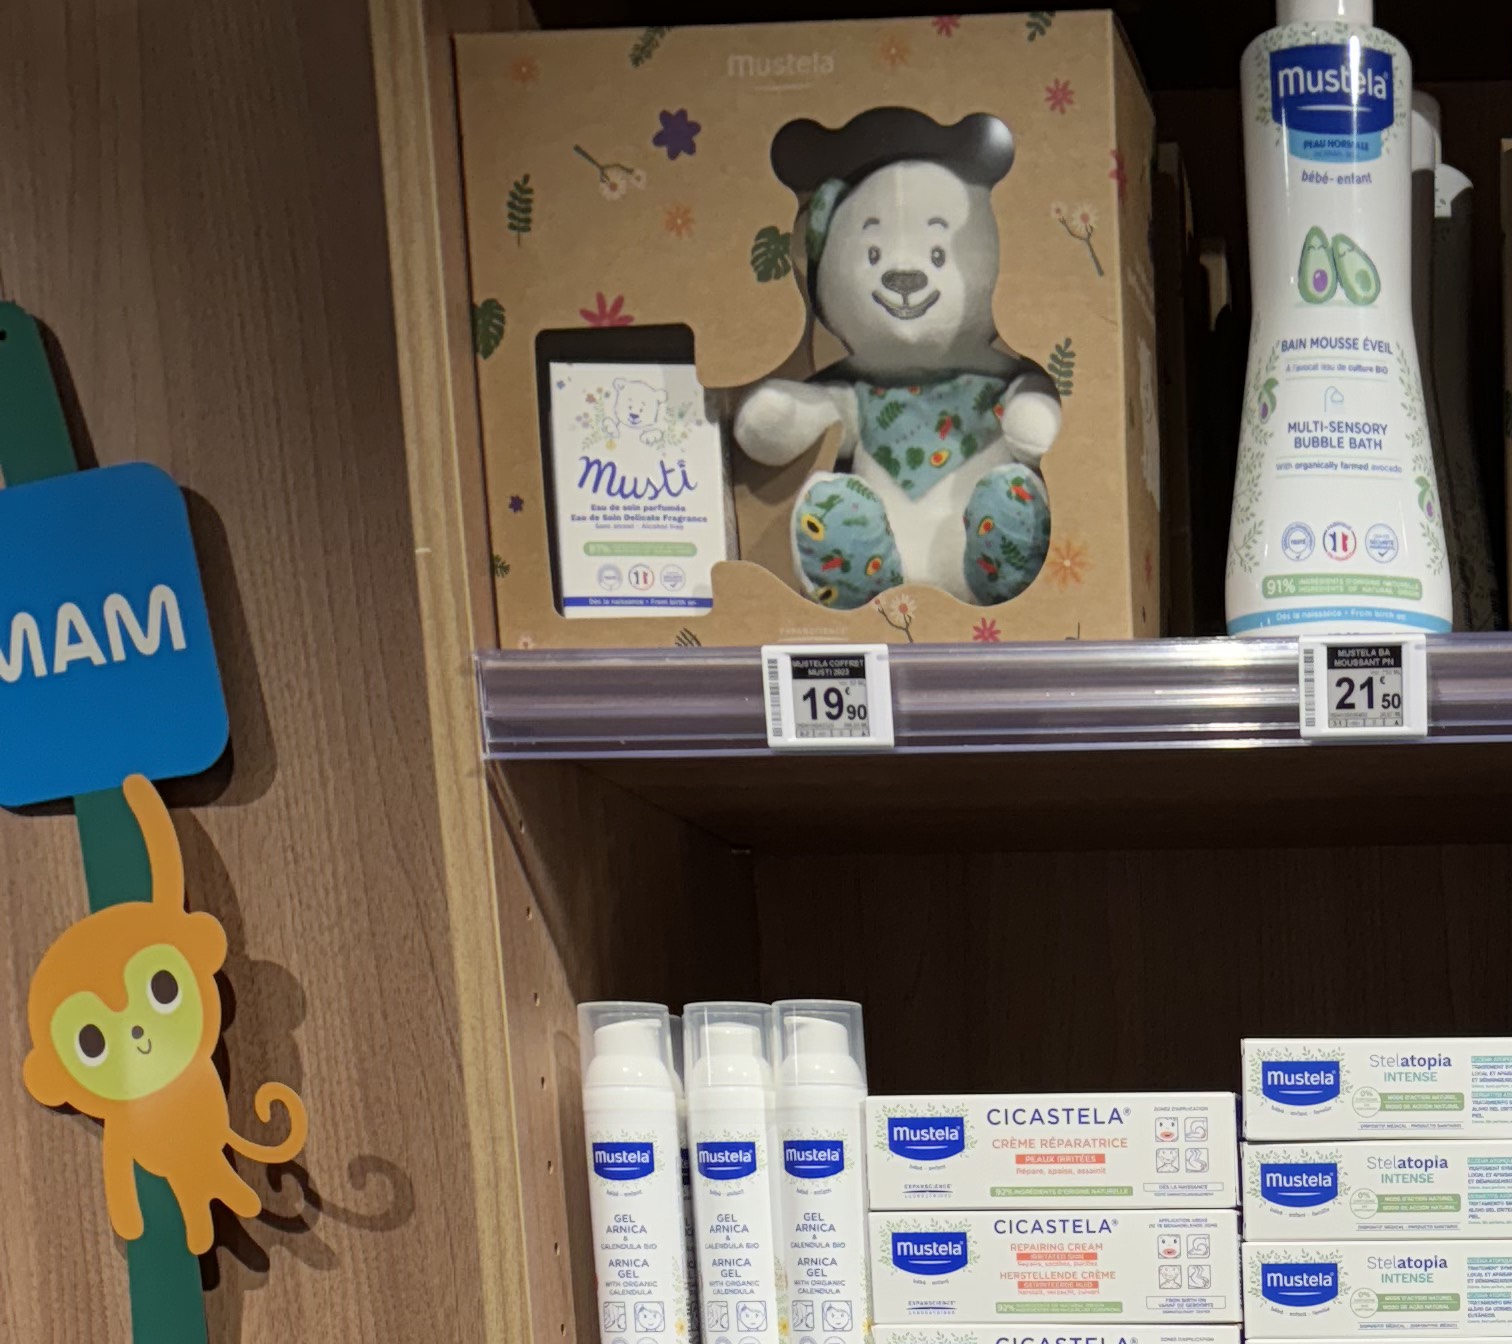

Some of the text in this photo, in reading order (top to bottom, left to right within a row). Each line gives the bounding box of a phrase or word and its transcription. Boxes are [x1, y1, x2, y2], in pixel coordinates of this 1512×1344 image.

[1281, 338, 1306, 352] BAIN
[1310, 336, 1359, 350] MOUSSE
[1288, 421, 1388, 435] MULTI-SENSORY
[1294, 437, 1382, 450] BUBBLE BATH
[578, 456, 698, 500] Musti
[1370, 1053, 1453, 1070] Stelatopia
[1267, 1069, 1334, 1086] Mustela
[1384, 1072, 1438, 1082] INTENSE
[987, 1107, 1123, 1126] CICASTELA
[893, 1124, 959, 1144] Mustela
[992, 1134, 1128, 1150] CRÈME RÉPARATRICE
[1367, 1157, 1448, 1173] Stelatopia
[1266, 1172, 1333, 1188] Mustela
[1381, 1173, 1434, 1184] INTENSE
[614, 1214, 636, 1224] GEL
[994, 1218, 1111, 1235] CICASTELA
[607, 1225, 647, 1235] ARNICA
[897, 1240, 963, 1259] Mustela
